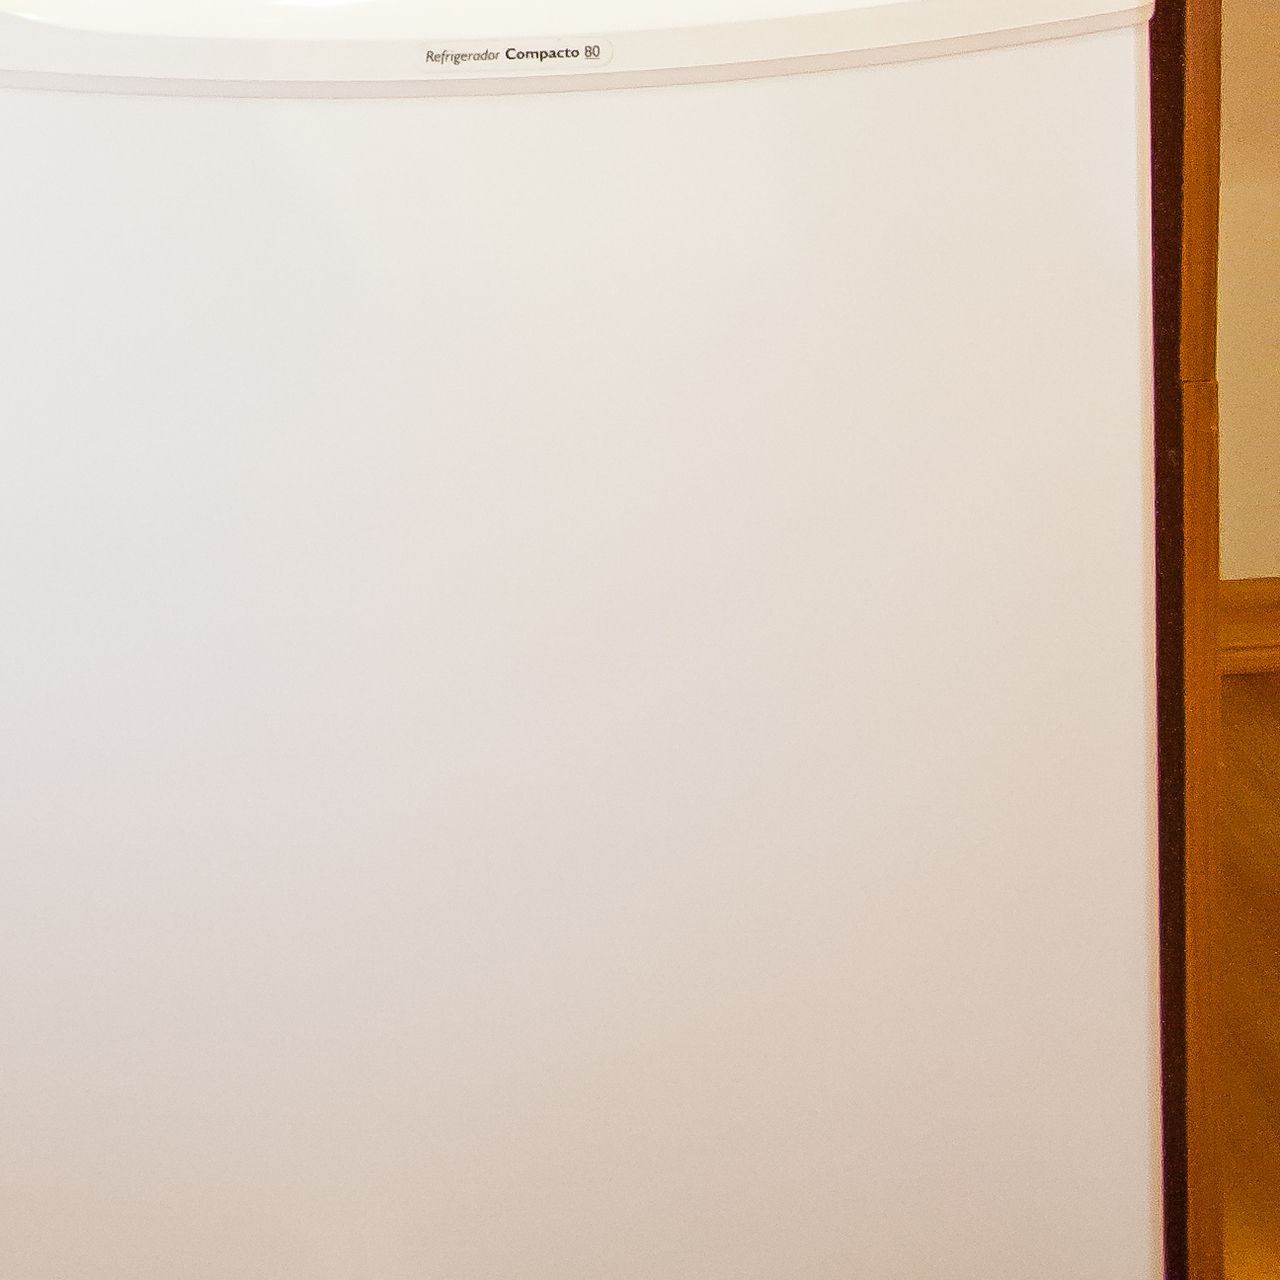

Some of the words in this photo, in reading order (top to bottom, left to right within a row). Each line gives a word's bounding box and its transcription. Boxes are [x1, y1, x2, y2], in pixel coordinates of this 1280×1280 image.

[425, 49, 500, 65] Refrigerador
[505, 47, 580, 62] Compacto
[584, 45, 601, 59] 80
